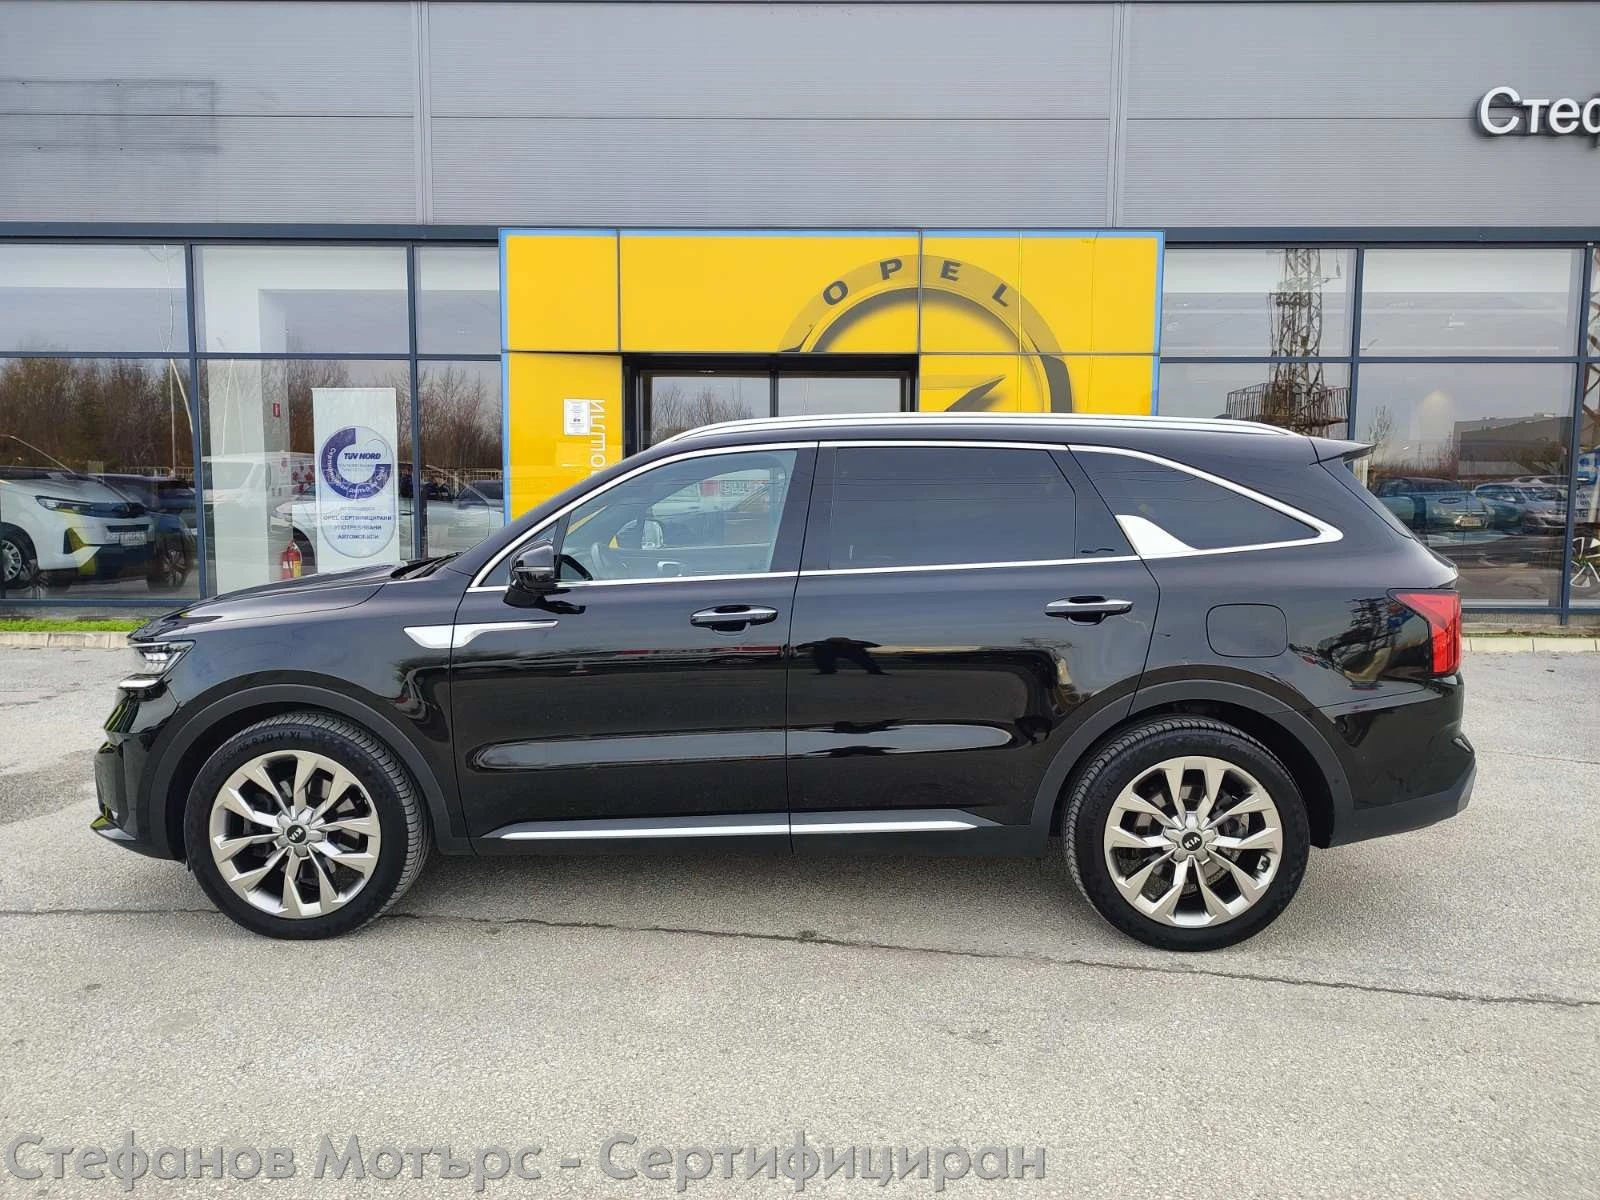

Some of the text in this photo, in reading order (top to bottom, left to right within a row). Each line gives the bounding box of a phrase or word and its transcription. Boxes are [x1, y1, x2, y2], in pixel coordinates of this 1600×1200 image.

[822, 258, 1009, 307] OPEL
[590, 399, 606, 475] ОШЛИ
[1184, 836, 1201, 849] KIA
